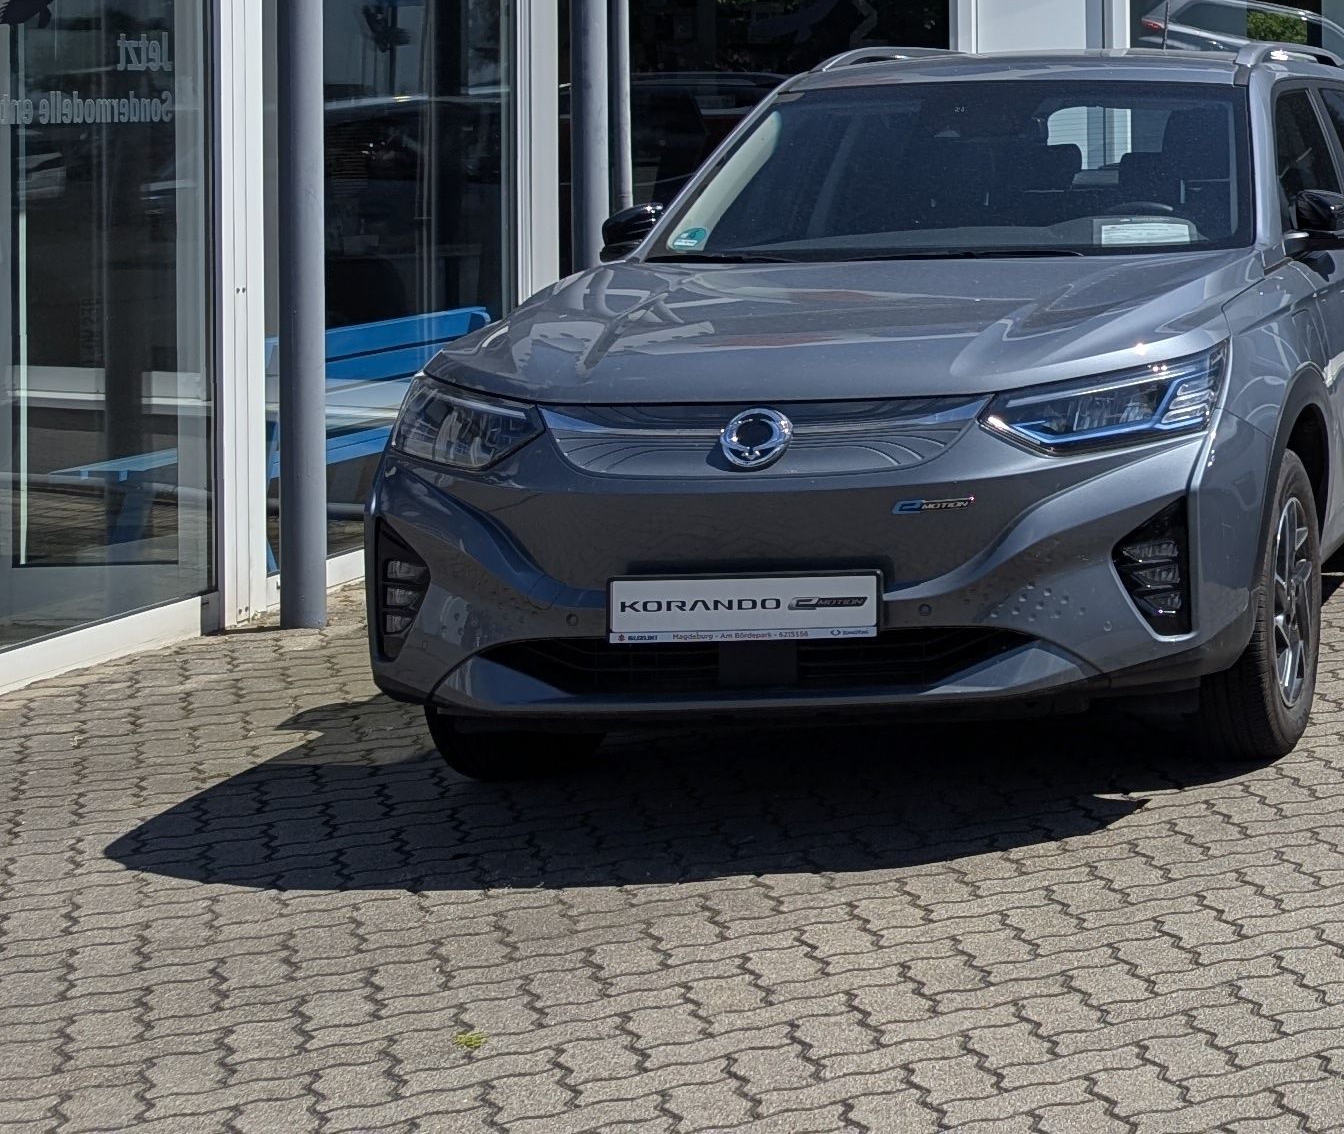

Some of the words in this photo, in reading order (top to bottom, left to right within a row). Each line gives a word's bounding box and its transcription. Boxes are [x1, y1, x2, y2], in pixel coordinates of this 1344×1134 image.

[620, 598, 781, 613] KORANDO
[672, 631, 714, 641] Magdeburg
[735, 631, 771, 640] Bördepark
